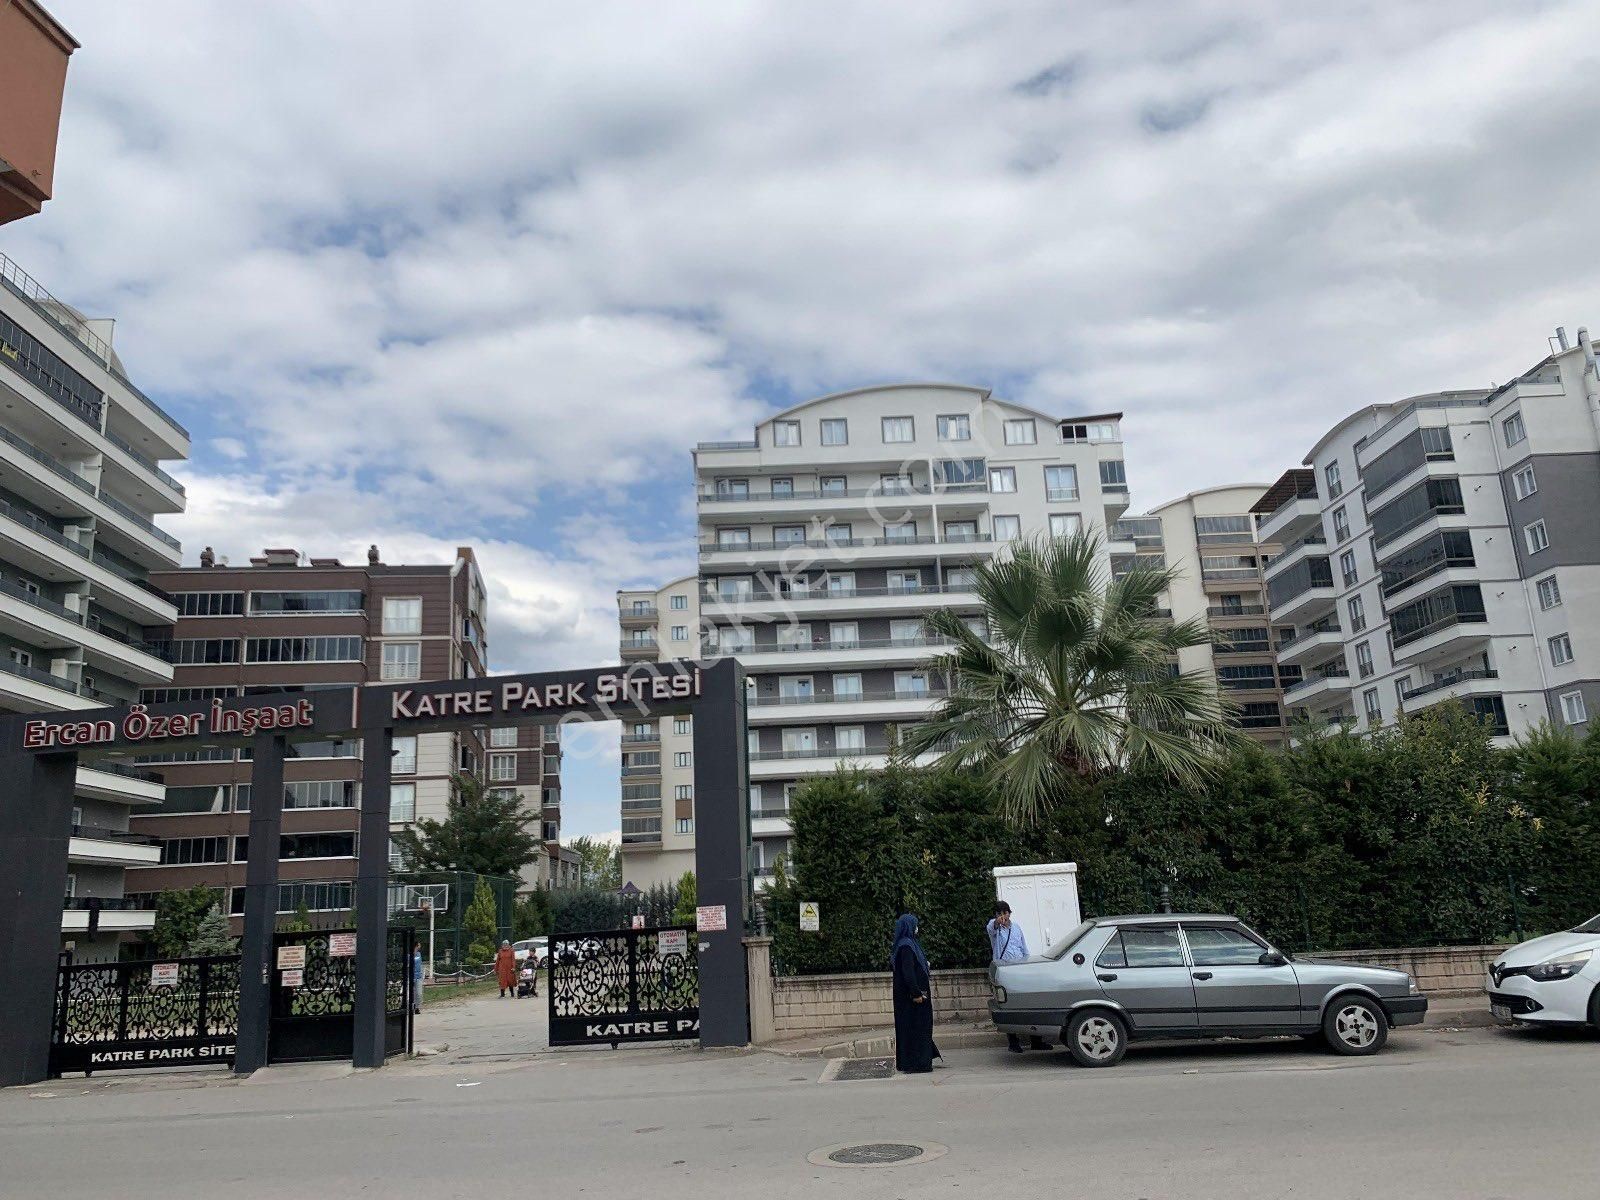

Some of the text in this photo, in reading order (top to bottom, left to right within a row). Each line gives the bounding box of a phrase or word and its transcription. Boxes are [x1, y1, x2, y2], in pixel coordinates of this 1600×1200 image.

[391, 667, 701, 719] KATRE PARK SİTESİ
[23, 698, 313, 747] Ercan Özer İnşaat
[586, 1021, 668, 1036] KATRE
[91, 1045, 235, 1063] KATRE PARK SİTE
